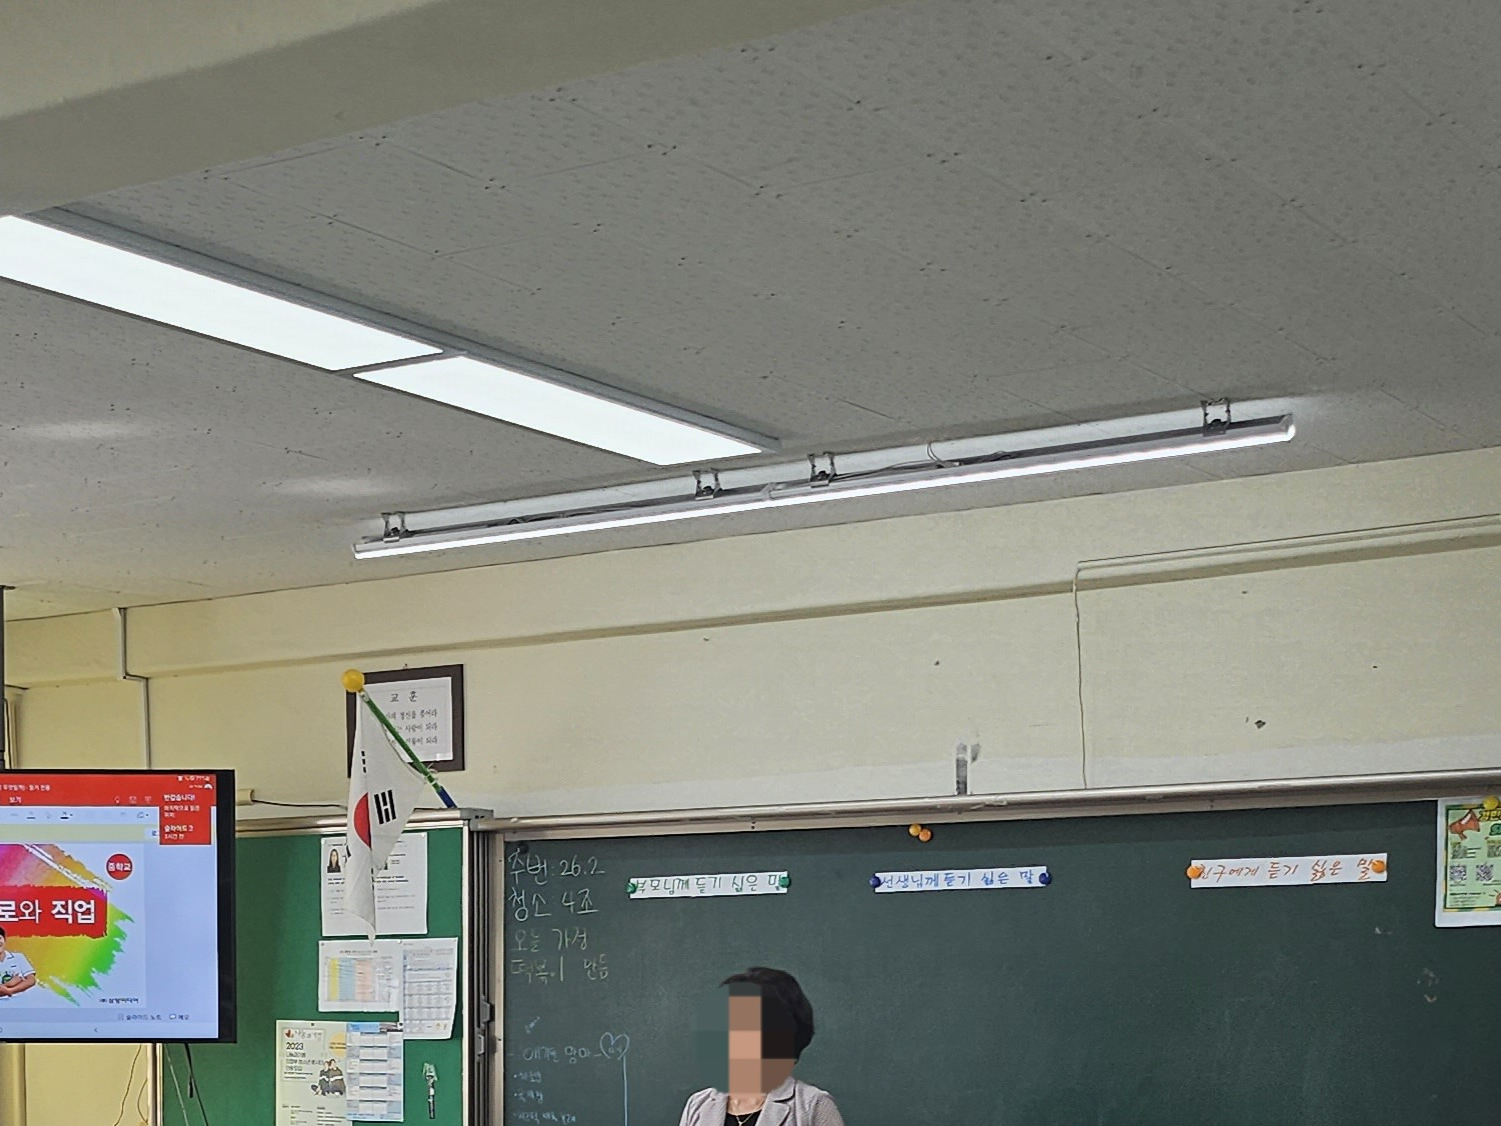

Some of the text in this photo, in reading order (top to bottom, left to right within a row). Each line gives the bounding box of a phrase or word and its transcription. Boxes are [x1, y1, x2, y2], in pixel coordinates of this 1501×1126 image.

[107, 861, 132, 872] 중학교
[559, 854, 605, 877] 26.2
[1199, 857, 1373, 883] 친구에게 듣기 싫은 말
[636, 876, 690, 896] 부모님께
[695, 876, 723, 894] 듣기
[881, 868, 1035, 890] 선생님께 듣기 싫은 말
[50, 898, 96, 925] 직업
[561, 887, 599, 915] 4조
[285, 1041, 304, 1051] 2023
